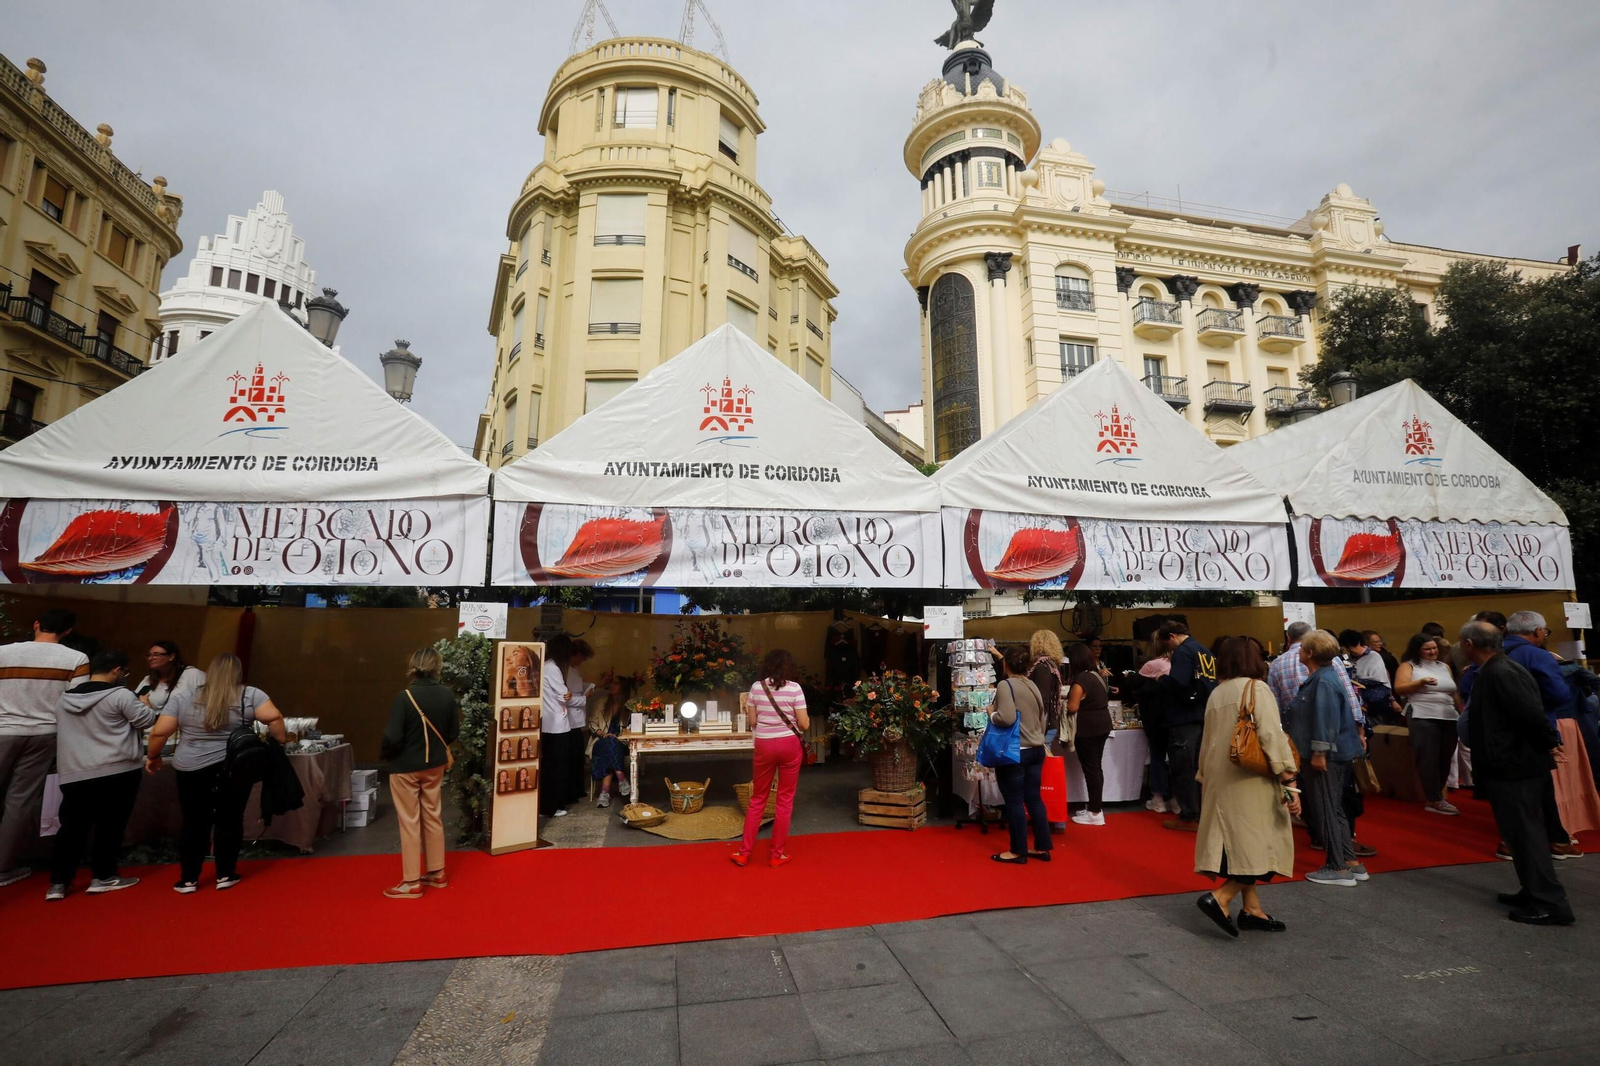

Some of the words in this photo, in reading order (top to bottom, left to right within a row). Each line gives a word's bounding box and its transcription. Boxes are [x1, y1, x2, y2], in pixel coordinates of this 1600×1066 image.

[1116, 250, 1152, 262] DIFICIO
[103, 455, 257, 470] AYUNTAMIENTO
[262, 455, 288, 471] DE
[292, 455, 379, 472] CORDOBA
[603, 461, 734, 479] AYUNTAMIENTO
[739, 463, 760, 480] DE
[765, 464, 841, 483] CORDOBA
[1028, 475, 1128, 495] AYUNTAMIENTO
[1131, 482, 1149, 496] DE
[1150, 483, 1211, 499] CORDOBA
[1353, 469, 1434, 487] AYUNTAMIENTO
[1435, 474, 1450, 487] DE
[1451, 473, 1501, 489] CORDOBA
[232, 506, 432, 541] MERCADO
[720, 514, 894, 545] MERCADO
[232, 537, 273, 562] DE
[1120, 526, 1250, 553] MERCADO
[1431, 530, 1542, 557] MERCADO
[722, 543, 758, 565] DE
[1124, 550, 1153, 570] DE
[1436, 552, 1461, 571] DE
